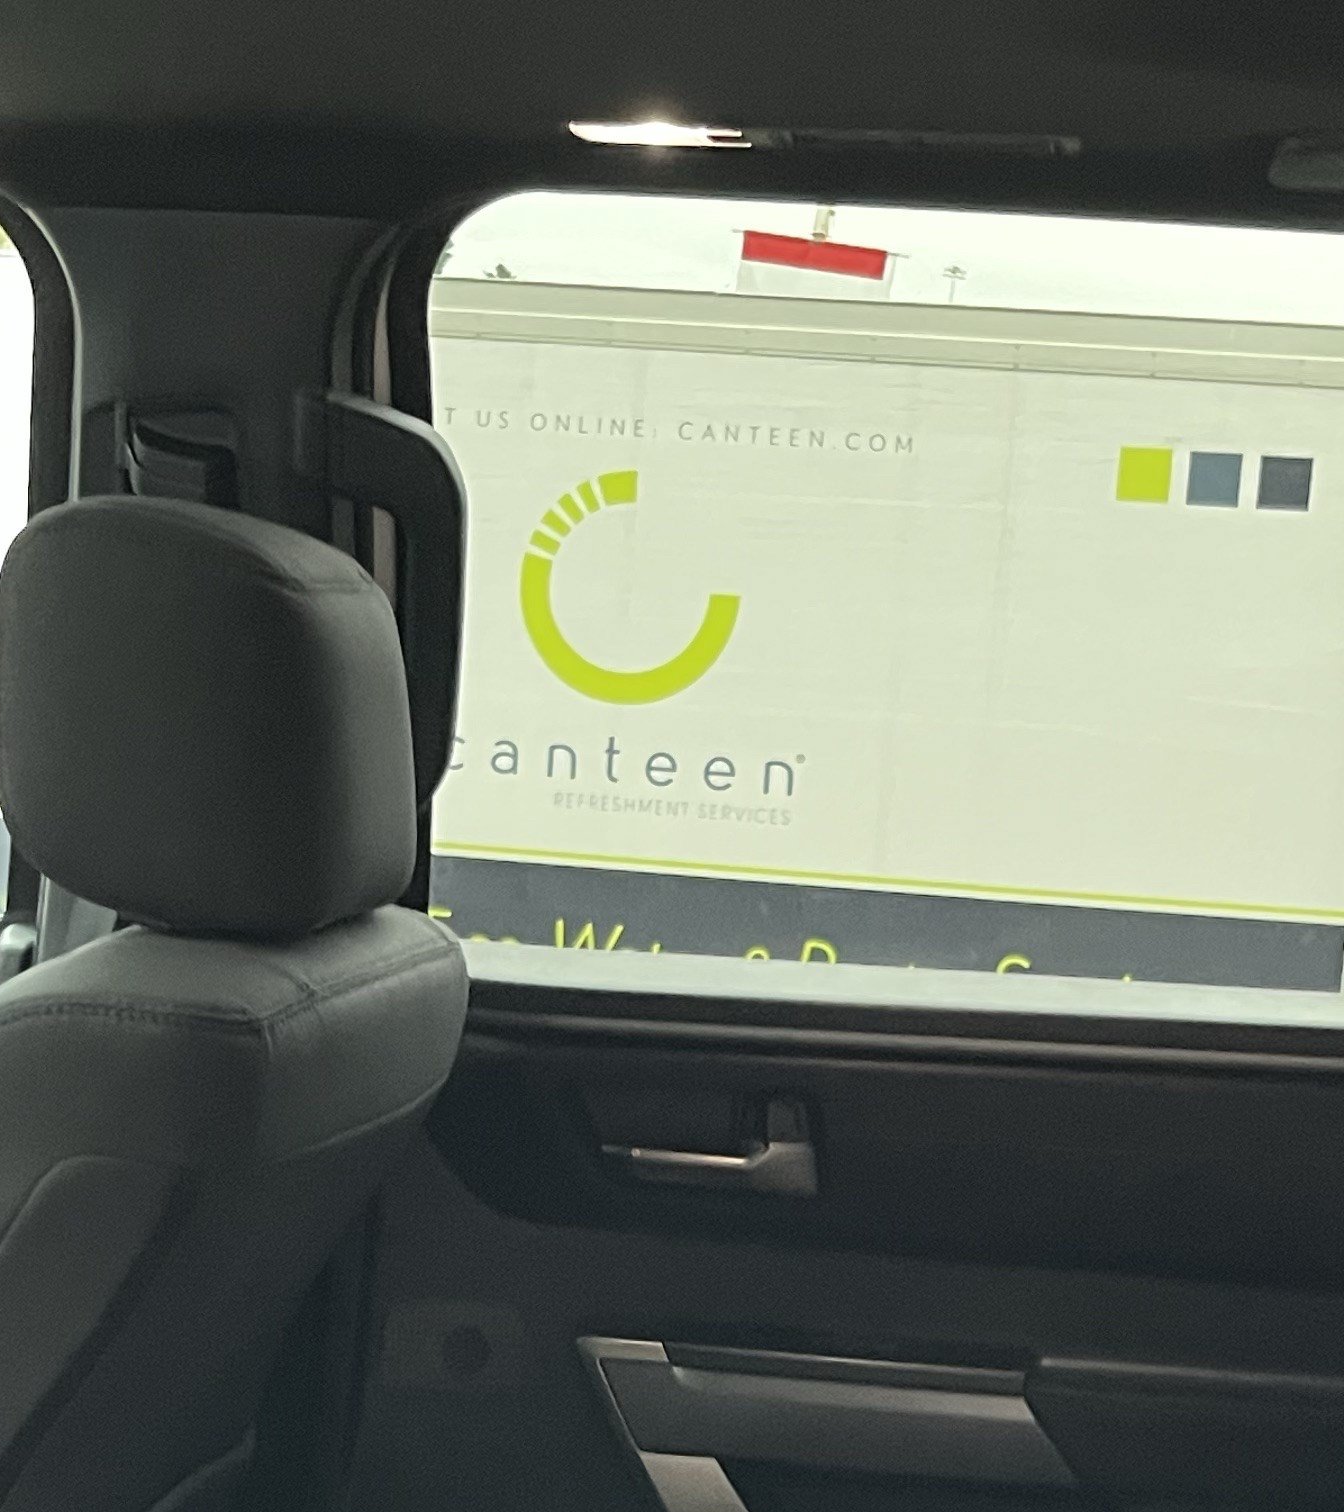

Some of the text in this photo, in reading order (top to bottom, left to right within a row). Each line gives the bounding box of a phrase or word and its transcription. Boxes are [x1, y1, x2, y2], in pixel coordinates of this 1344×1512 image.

[475, 409, 510, 430] US
[677, 420, 914, 454] CANTEEN.COM
[553, 791, 793, 827] REFRESHMENT SERVICES
